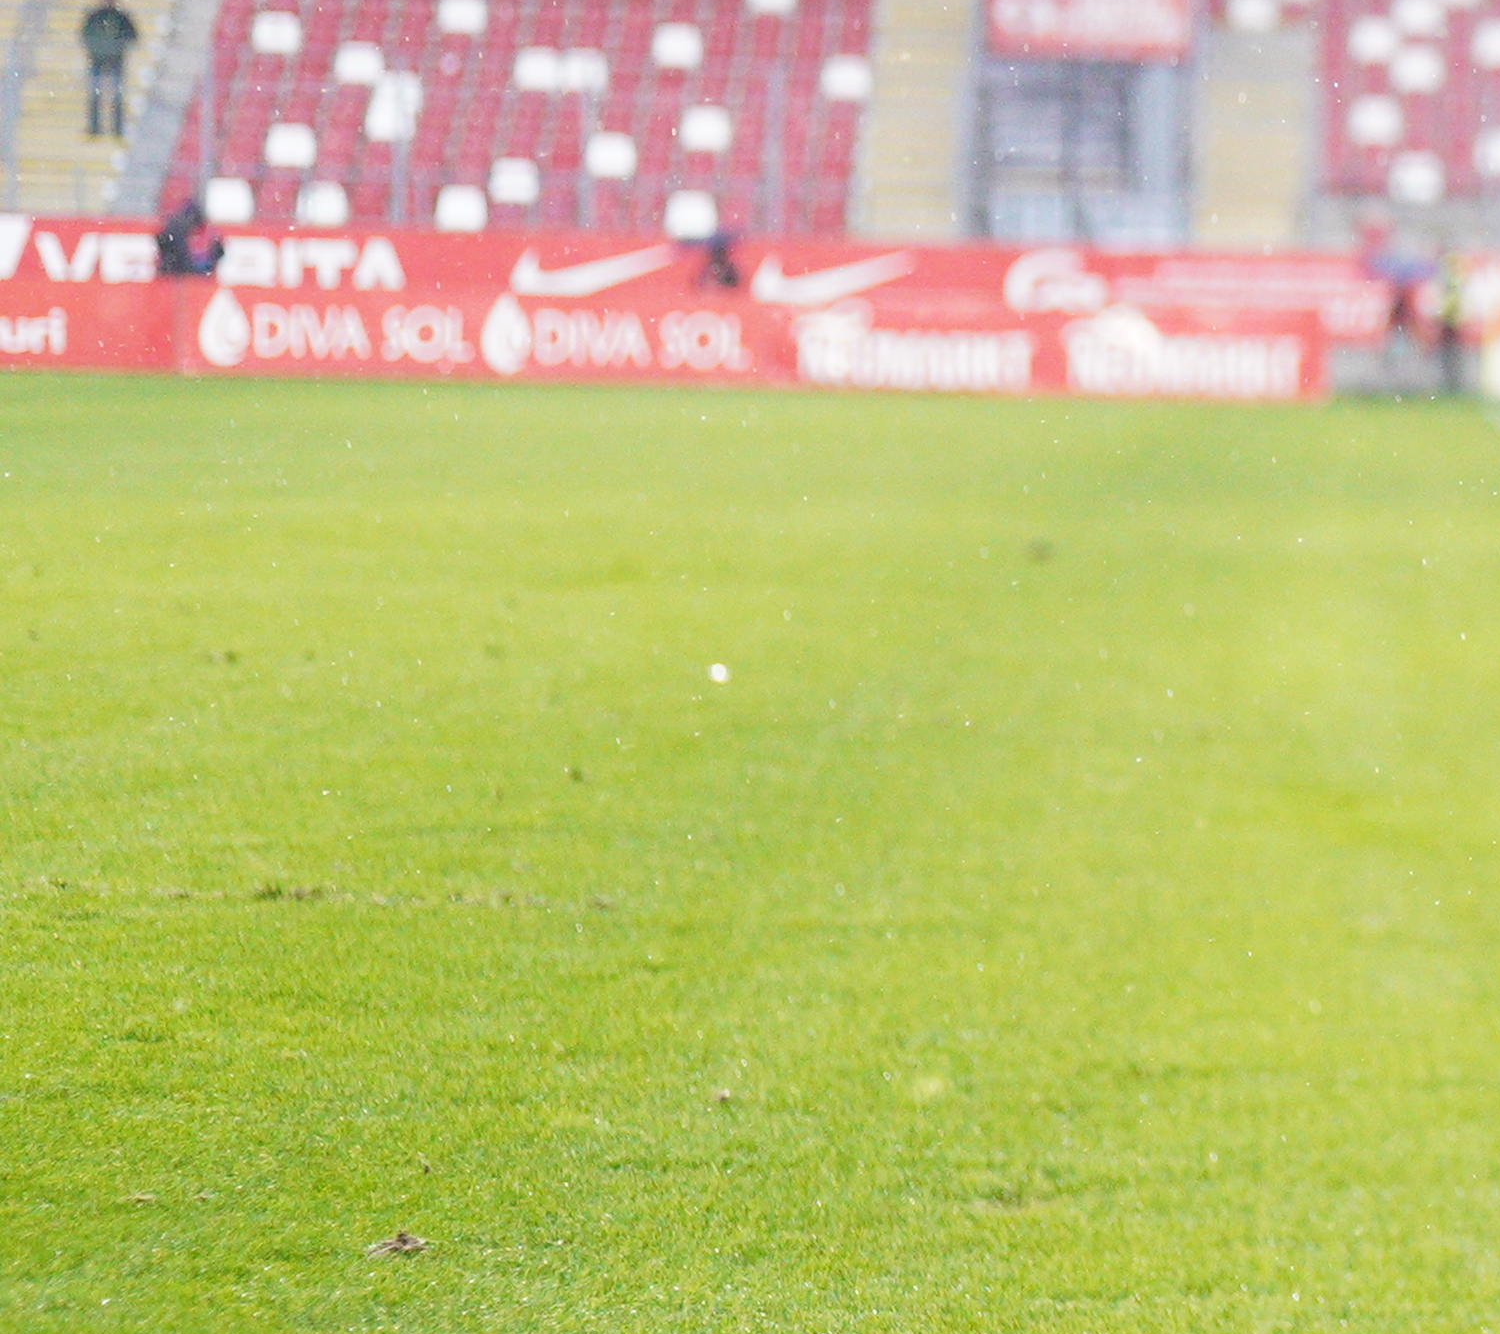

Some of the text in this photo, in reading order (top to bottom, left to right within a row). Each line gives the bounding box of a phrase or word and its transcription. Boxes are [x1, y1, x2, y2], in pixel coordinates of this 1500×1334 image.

[252, 303, 475, 363] DIVA SOL
[533, 307, 652, 366] DIVA
